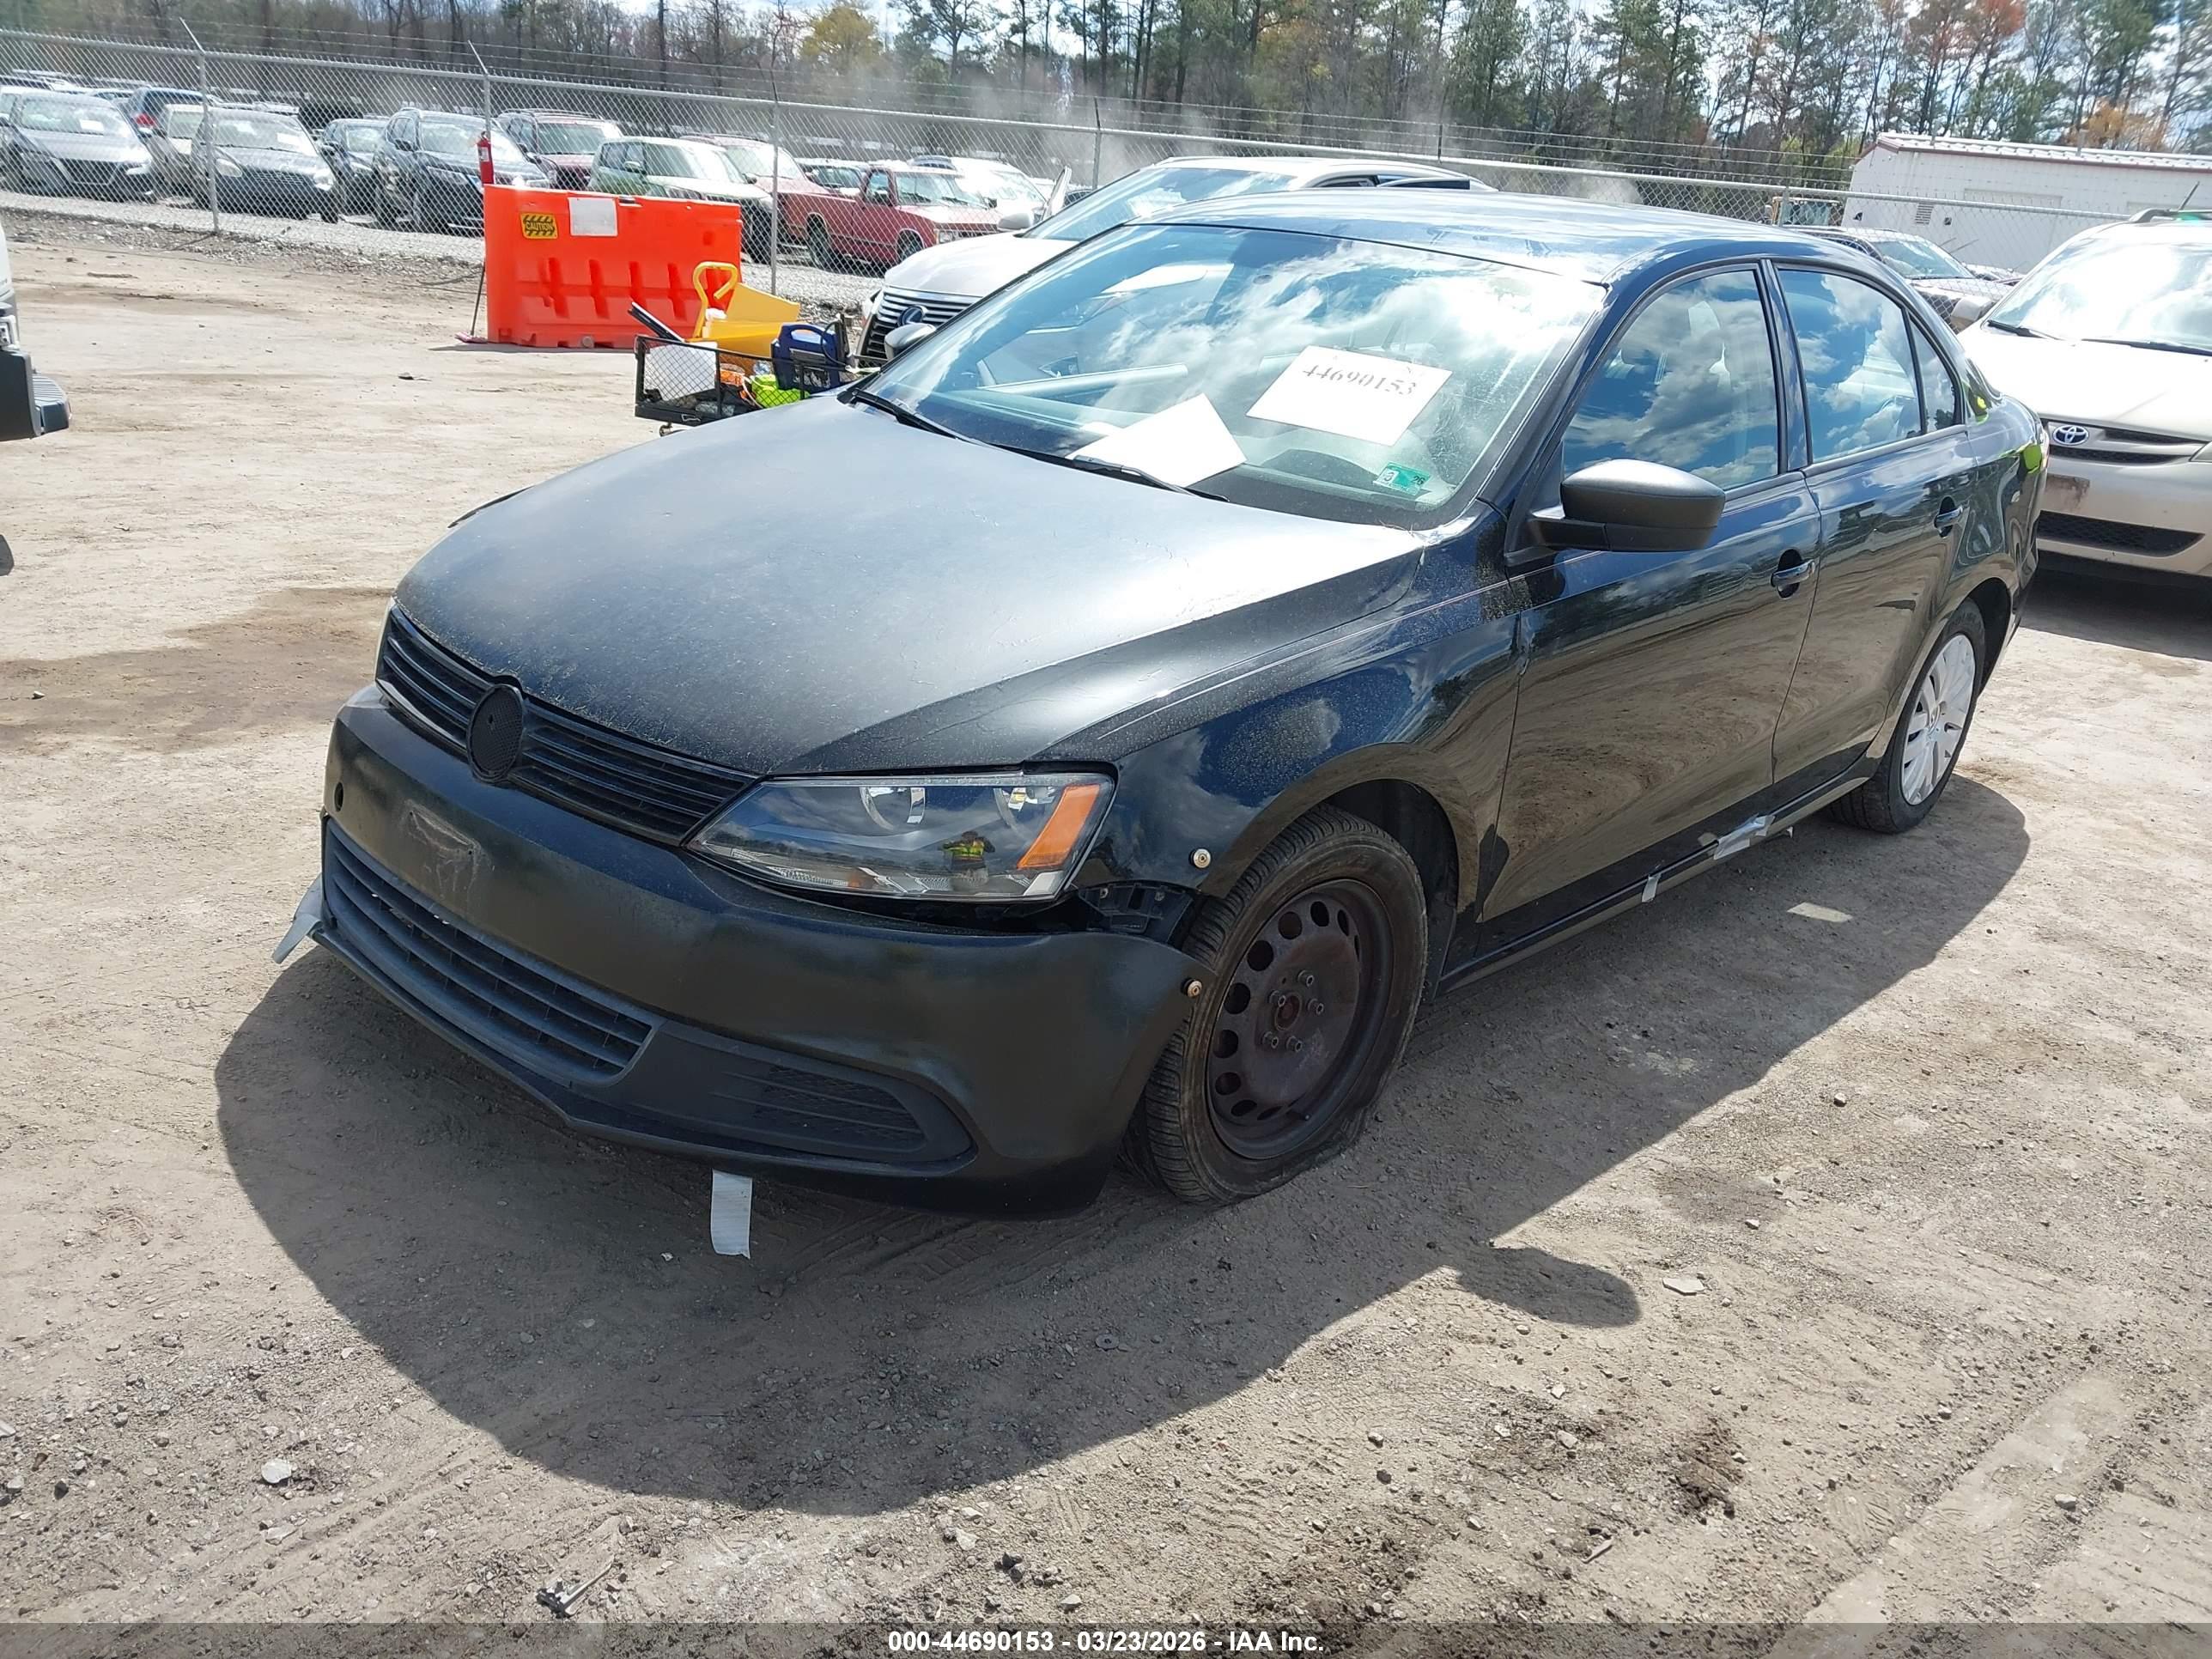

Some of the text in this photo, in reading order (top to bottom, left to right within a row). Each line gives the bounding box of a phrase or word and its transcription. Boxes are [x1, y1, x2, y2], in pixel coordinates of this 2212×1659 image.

[526, 221, 554, 232] CAUTION
[1302, 364, 1417, 395] 44690153
[1411, 475, 1426, 486] 26
